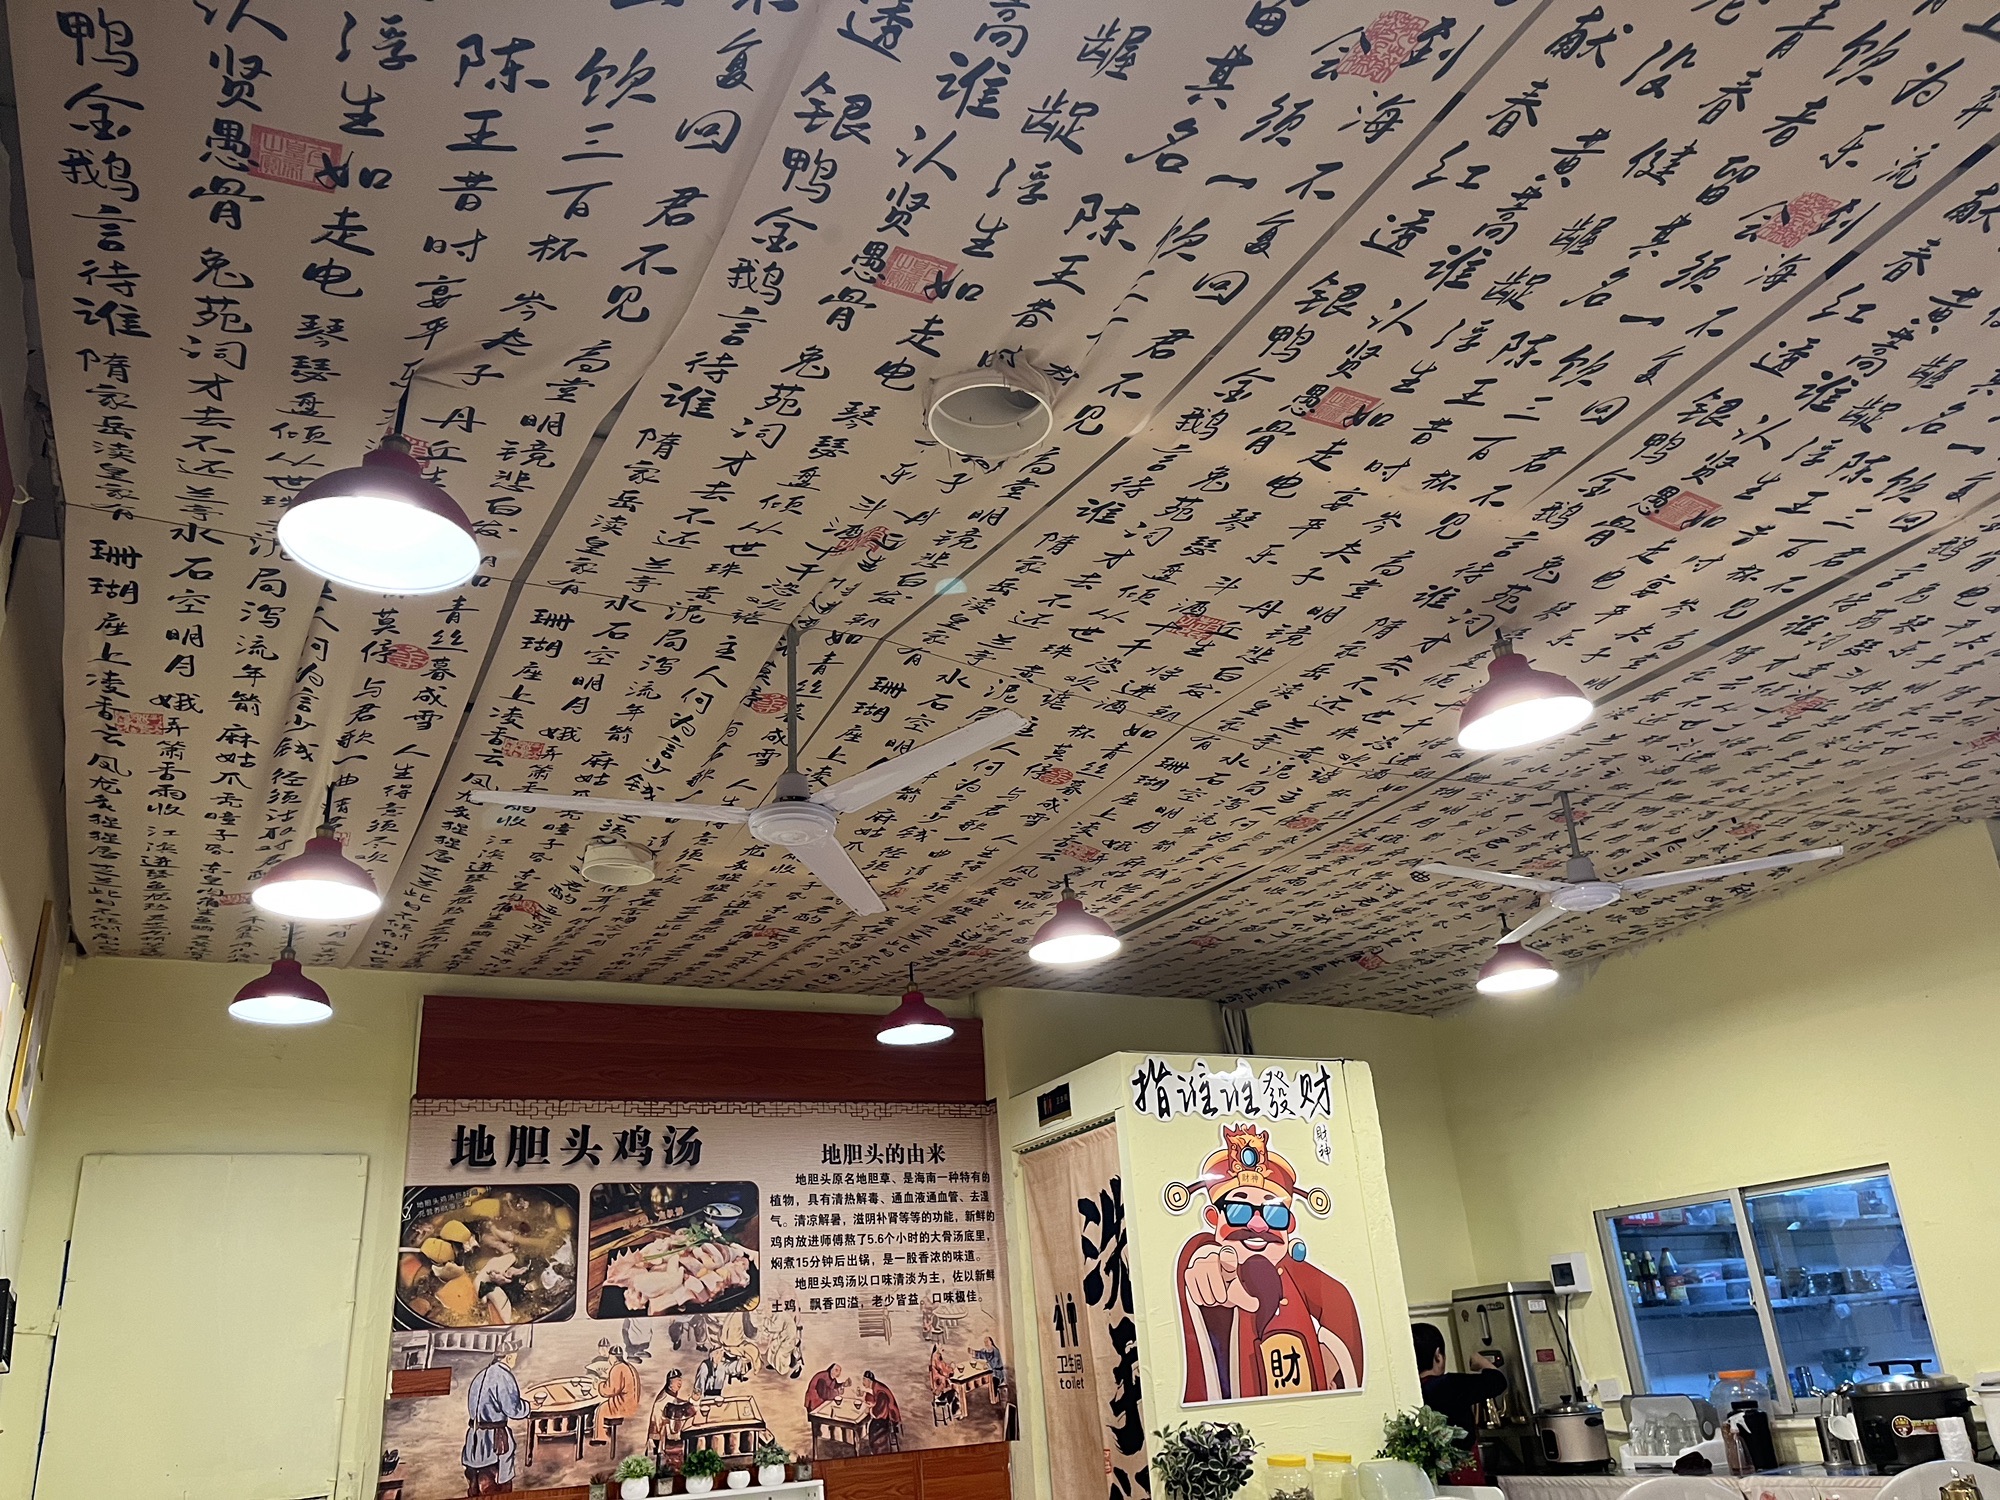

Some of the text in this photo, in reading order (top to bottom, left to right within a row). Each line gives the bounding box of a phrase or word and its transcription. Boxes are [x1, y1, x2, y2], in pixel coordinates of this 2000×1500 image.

[450, 1124, 703, 1168] 地胆头鸡汤
[821, 1143, 946, 1165] 地胆头的由来
[796, 1171, 990, 1186] 地胆头原名地胆草、是海南一种特有的
[795, 1269, 995, 1290] 地胆头鸡汤以口味清淡为主，佐以新鲜
[1056, 1354, 1083, 1375] 卫生间
[1059, 1377, 1085, 1391] toilet
